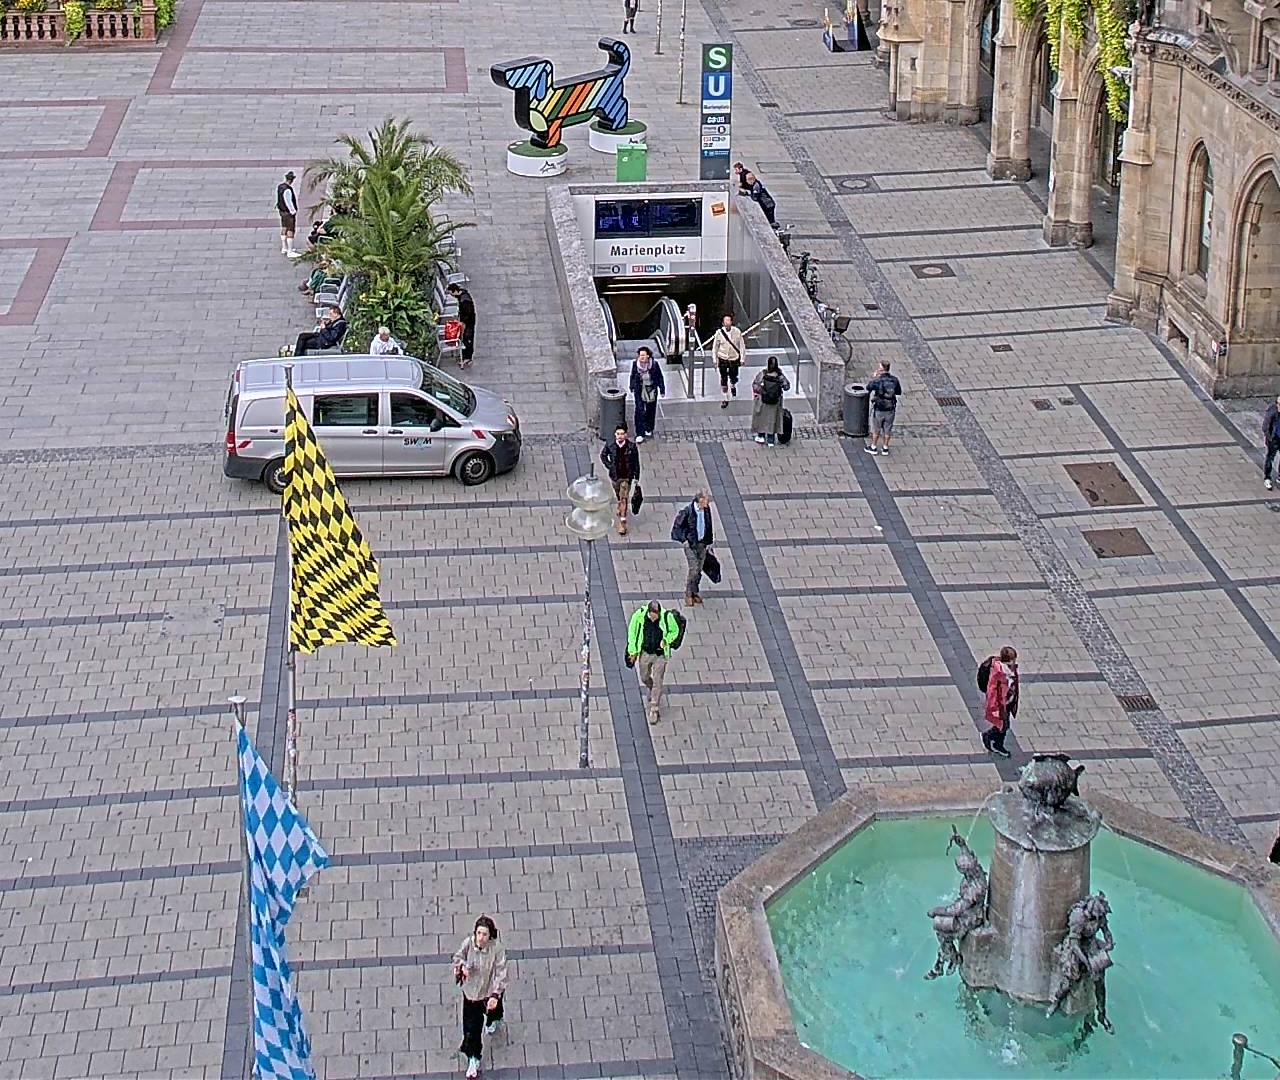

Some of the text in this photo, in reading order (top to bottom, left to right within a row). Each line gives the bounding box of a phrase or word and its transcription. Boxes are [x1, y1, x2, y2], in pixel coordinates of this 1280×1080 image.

[708, 47, 727, 69] S
[708, 75, 725, 97] U
[610, 243, 686, 258] Marienplatz
